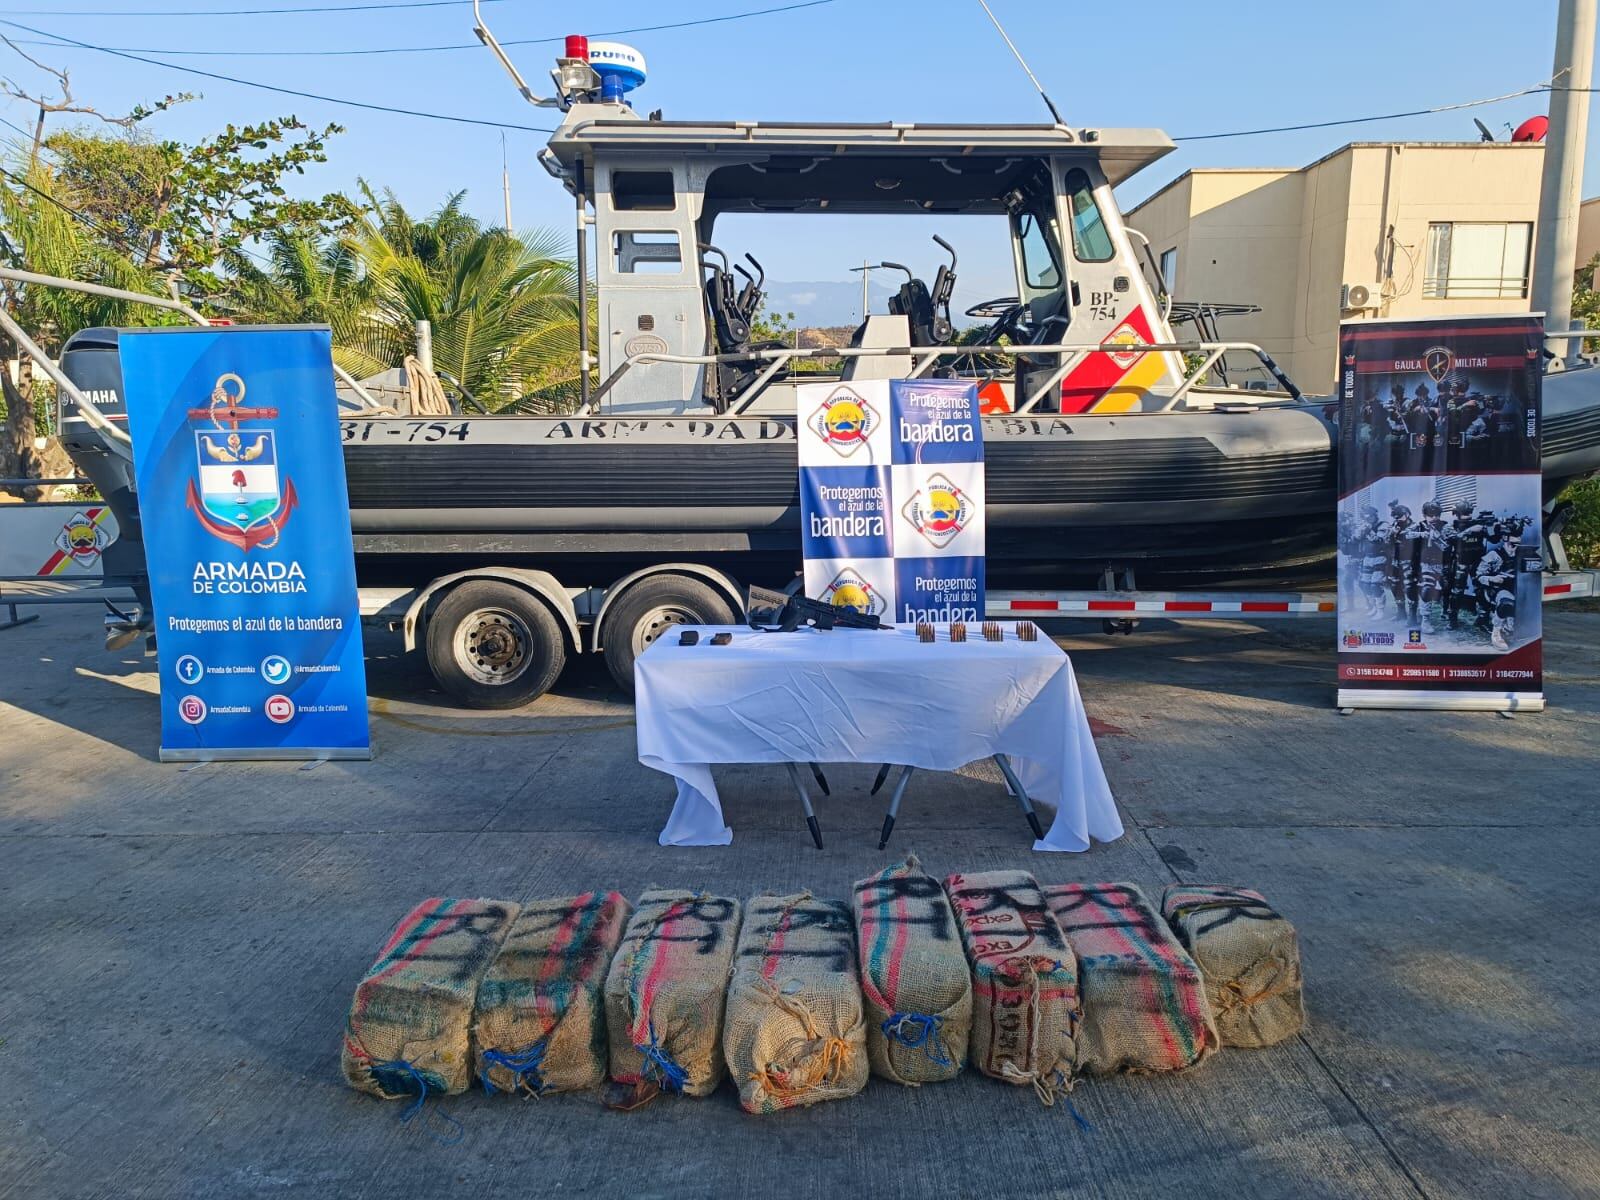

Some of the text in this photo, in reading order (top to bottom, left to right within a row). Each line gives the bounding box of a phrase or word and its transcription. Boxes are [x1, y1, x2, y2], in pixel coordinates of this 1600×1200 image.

[590, 51, 635, 62] RUNO
[1090, 292, 1119, 305] BP-
[1090, 307, 1117, 320] 754
[1394, 358, 1488, 370] GAULA MILITAR
[1345, 370, 1354, 389] TODOS
[909, 392, 970, 410] Protegemos
[928, 408, 971, 419] el azul de la
[900, 418, 974, 443] bandera
[1527, 418, 1536, 437] TODOS
[820, 485, 883, 501] Protegemos
[839, 500, 884, 512] el azul de la
[811, 512, 884, 538] bandera
[193, 561, 306, 580] ARMADA
[193, 581, 307, 594] DE COLOMBIA
[915, 577, 977, 593] Protegemos
[934, 592, 977, 602] el azul de la
[905, 605, 977, 623] bandera
[169, 616, 343, 634] Protegemos el azul de la bandera
[206, 666, 224, 674] Armada
[294, 664, 341, 673] @ArmadaColombia
[210, 705, 251, 713] ArmadaColombia
[298, 705, 317, 713] Armada
[325, 704, 348, 712] Colombia
